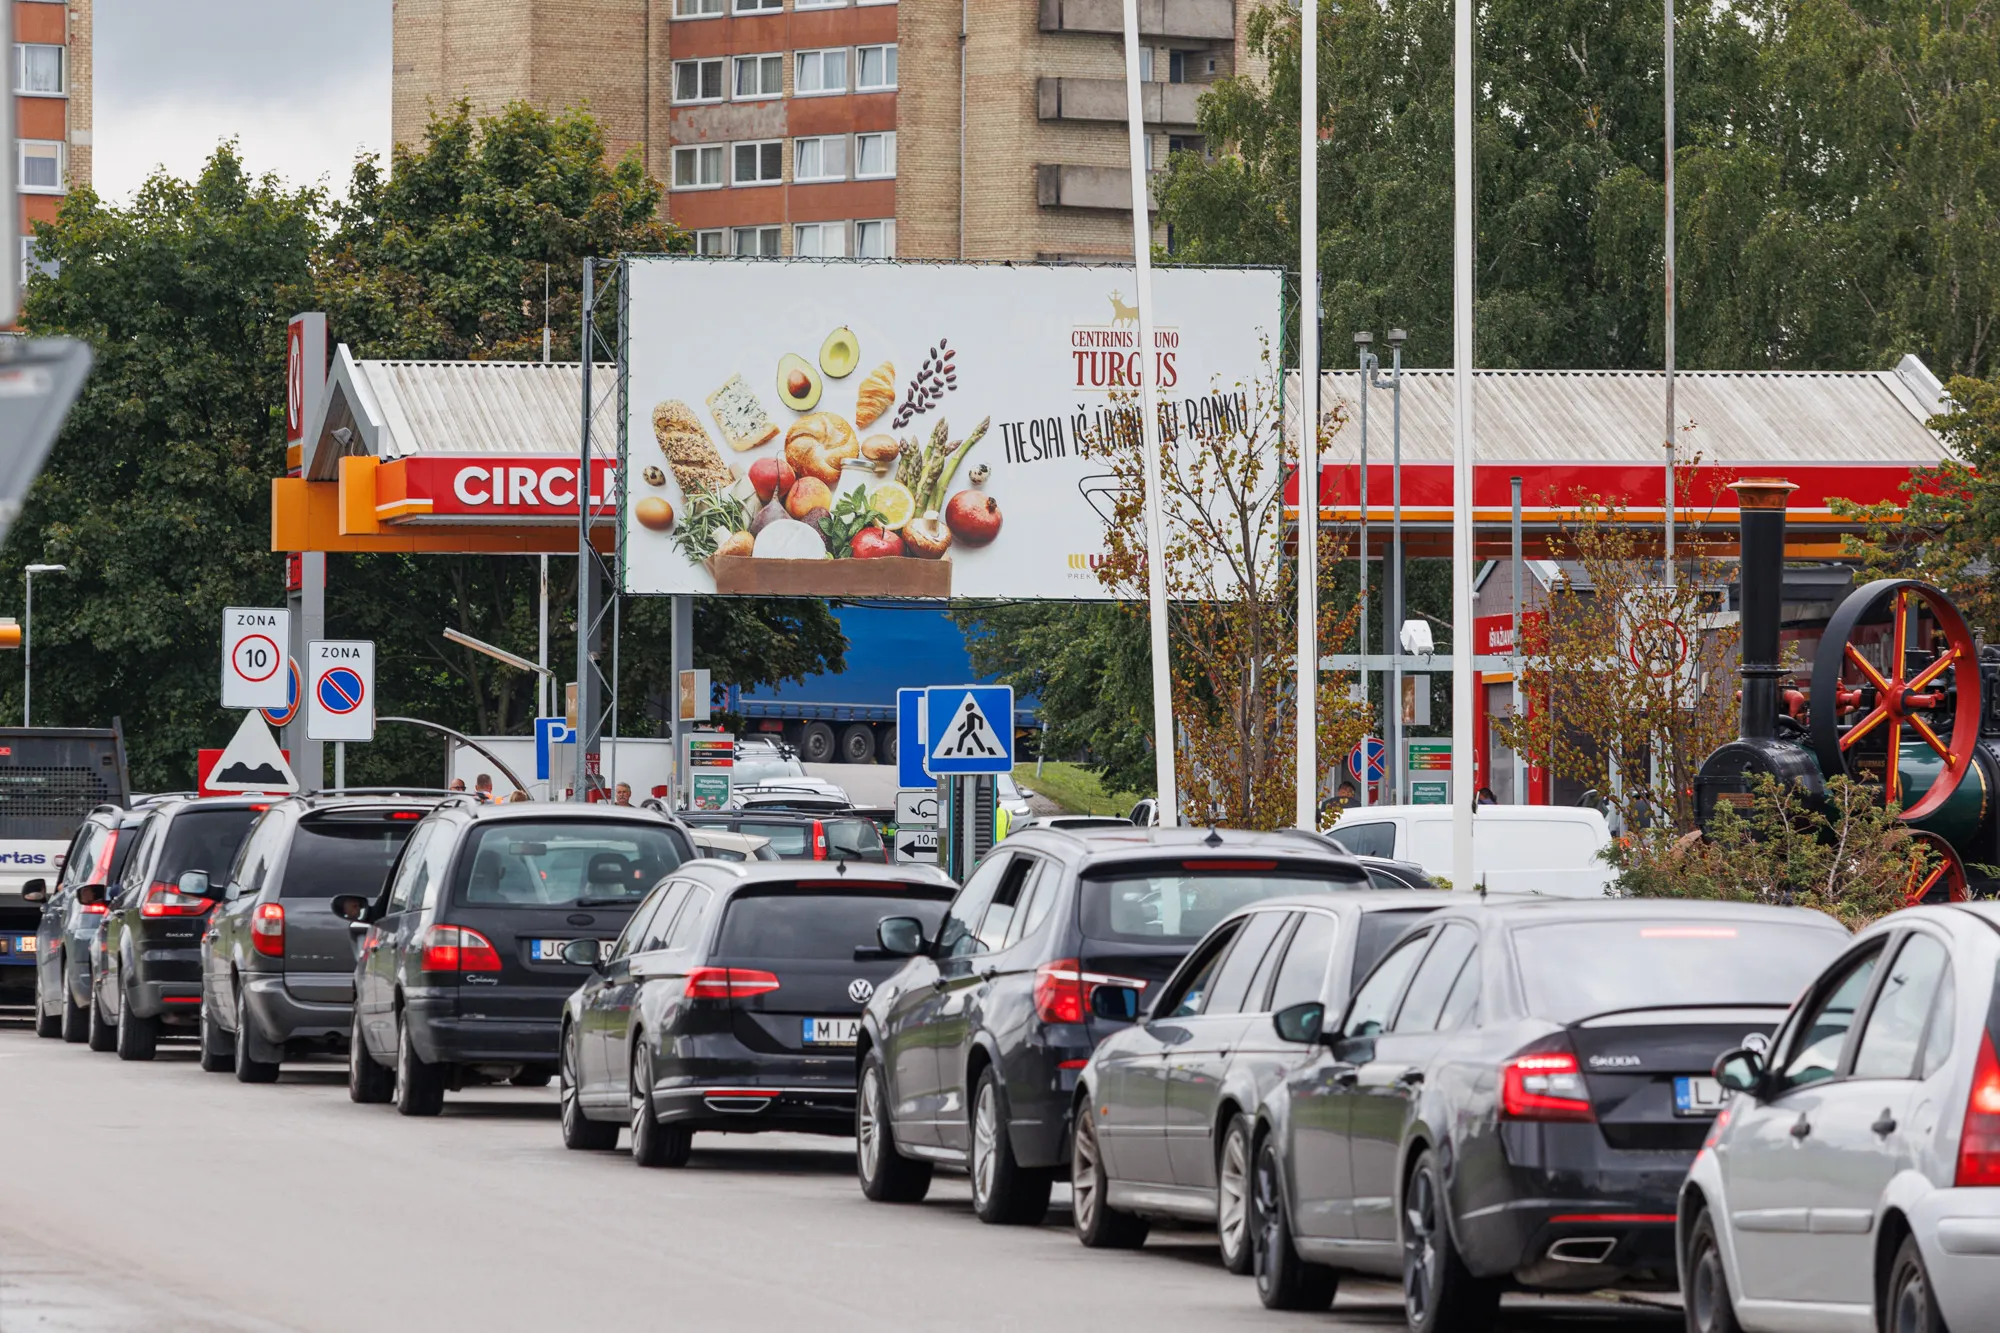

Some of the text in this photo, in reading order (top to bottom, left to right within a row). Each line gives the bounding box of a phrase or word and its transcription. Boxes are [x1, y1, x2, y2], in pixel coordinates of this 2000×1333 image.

[1071, 331, 1179, 348] CENTRINIS UNO
[1072, 351, 1177, 387] TURGS
[999, 416, 1066, 463] TIESIAI
[1071, 403, 1089, 456] IŠ
[237, 614, 277, 626] ZONA
[245, 649, 267, 668] 10
[321, 647, 361, 658] ZONA
[547, 722, 569, 744] P
[917, 834, 930, 845] 10
[466, 974, 499, 986] Galaxy
